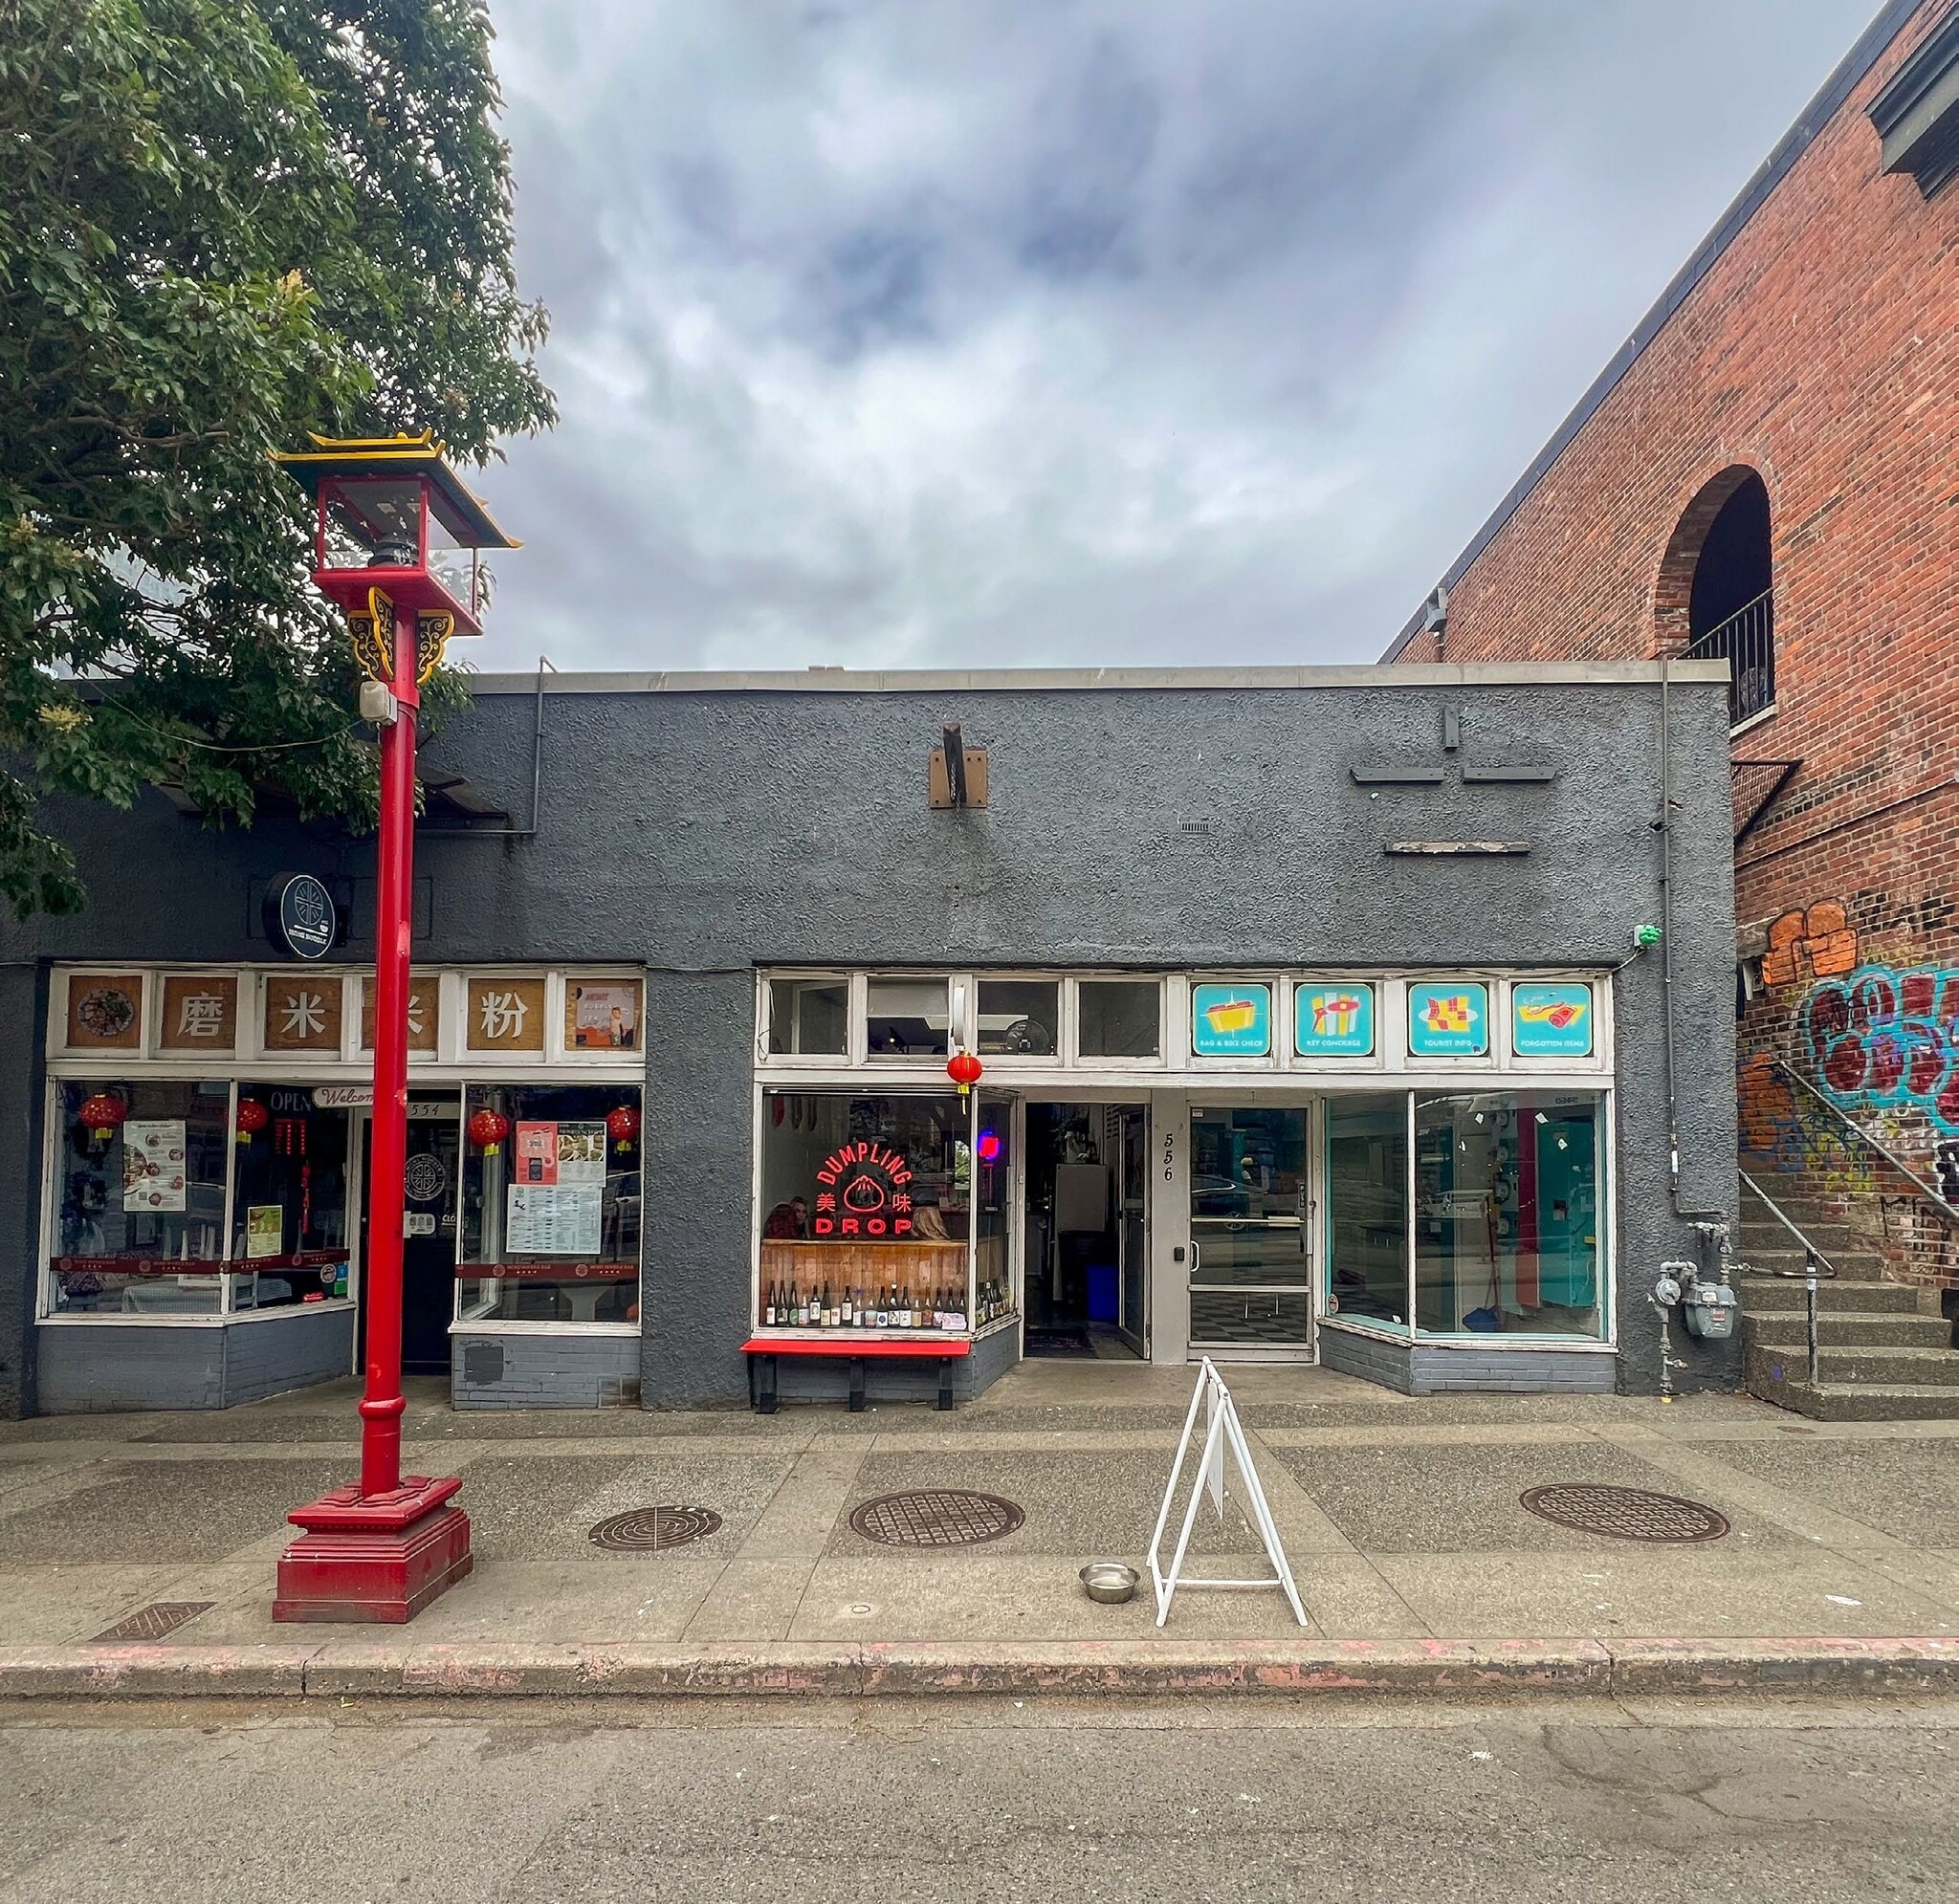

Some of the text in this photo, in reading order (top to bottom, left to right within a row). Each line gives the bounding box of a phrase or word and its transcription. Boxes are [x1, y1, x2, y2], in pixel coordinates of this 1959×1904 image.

[271, 1091, 312, 1112] OPEN
[321, 1088, 374, 1105] Welcom
[410, 1104, 440, 1116] 554
[816, 1142, 913, 1186] DUMPLING
[816, 1192, 912, 1213] 美 味
[816, 1218, 912, 1235] DROP
